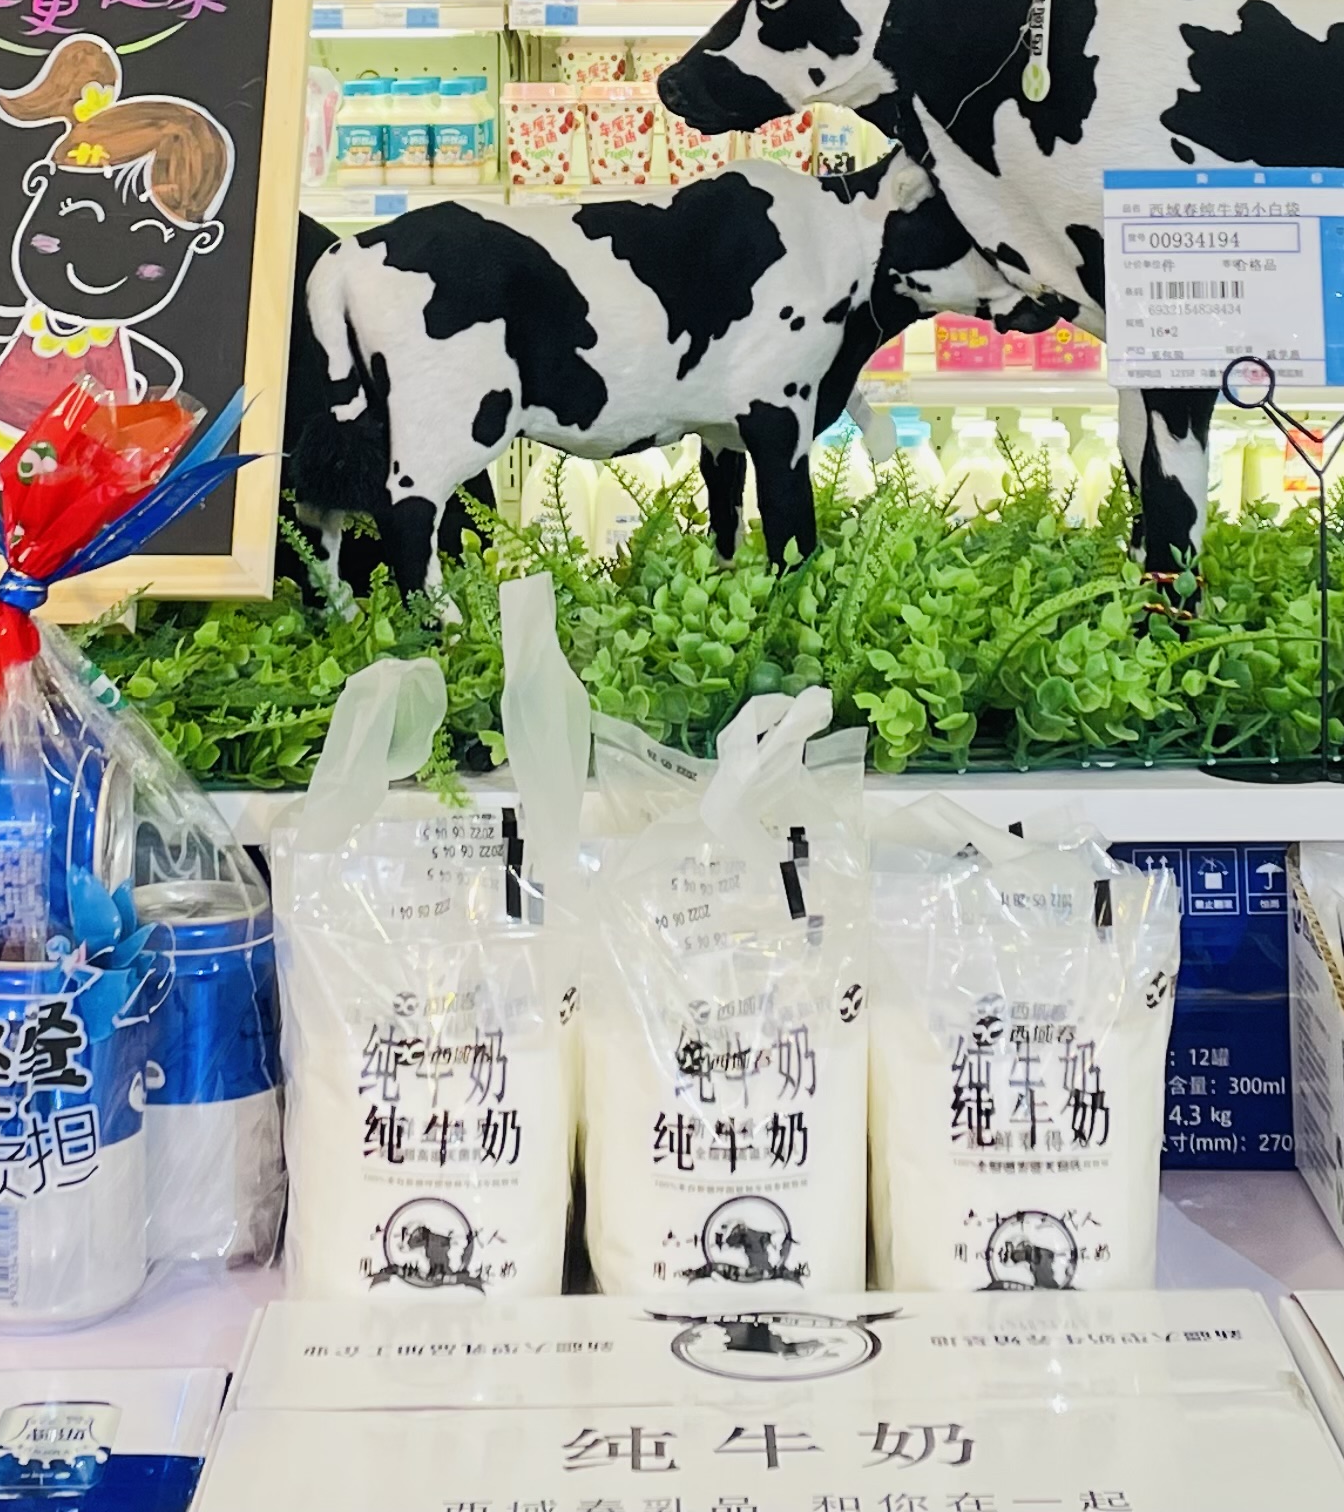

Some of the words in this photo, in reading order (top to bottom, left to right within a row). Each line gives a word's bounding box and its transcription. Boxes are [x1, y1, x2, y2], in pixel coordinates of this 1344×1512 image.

[1148, 231, 1241, 250] 00934194
[362, 1104, 523, 1169] 纯牛奶
[653, 1111, 809, 1174] 纯牛奶
[950, 1085, 1110, 1150] 纯牛奶
[1168, 1106, 1203, 1127] 4.3
[1210, 1105, 1233, 1128] kg
[561, 1423, 976, 1473] 纯牛奶
